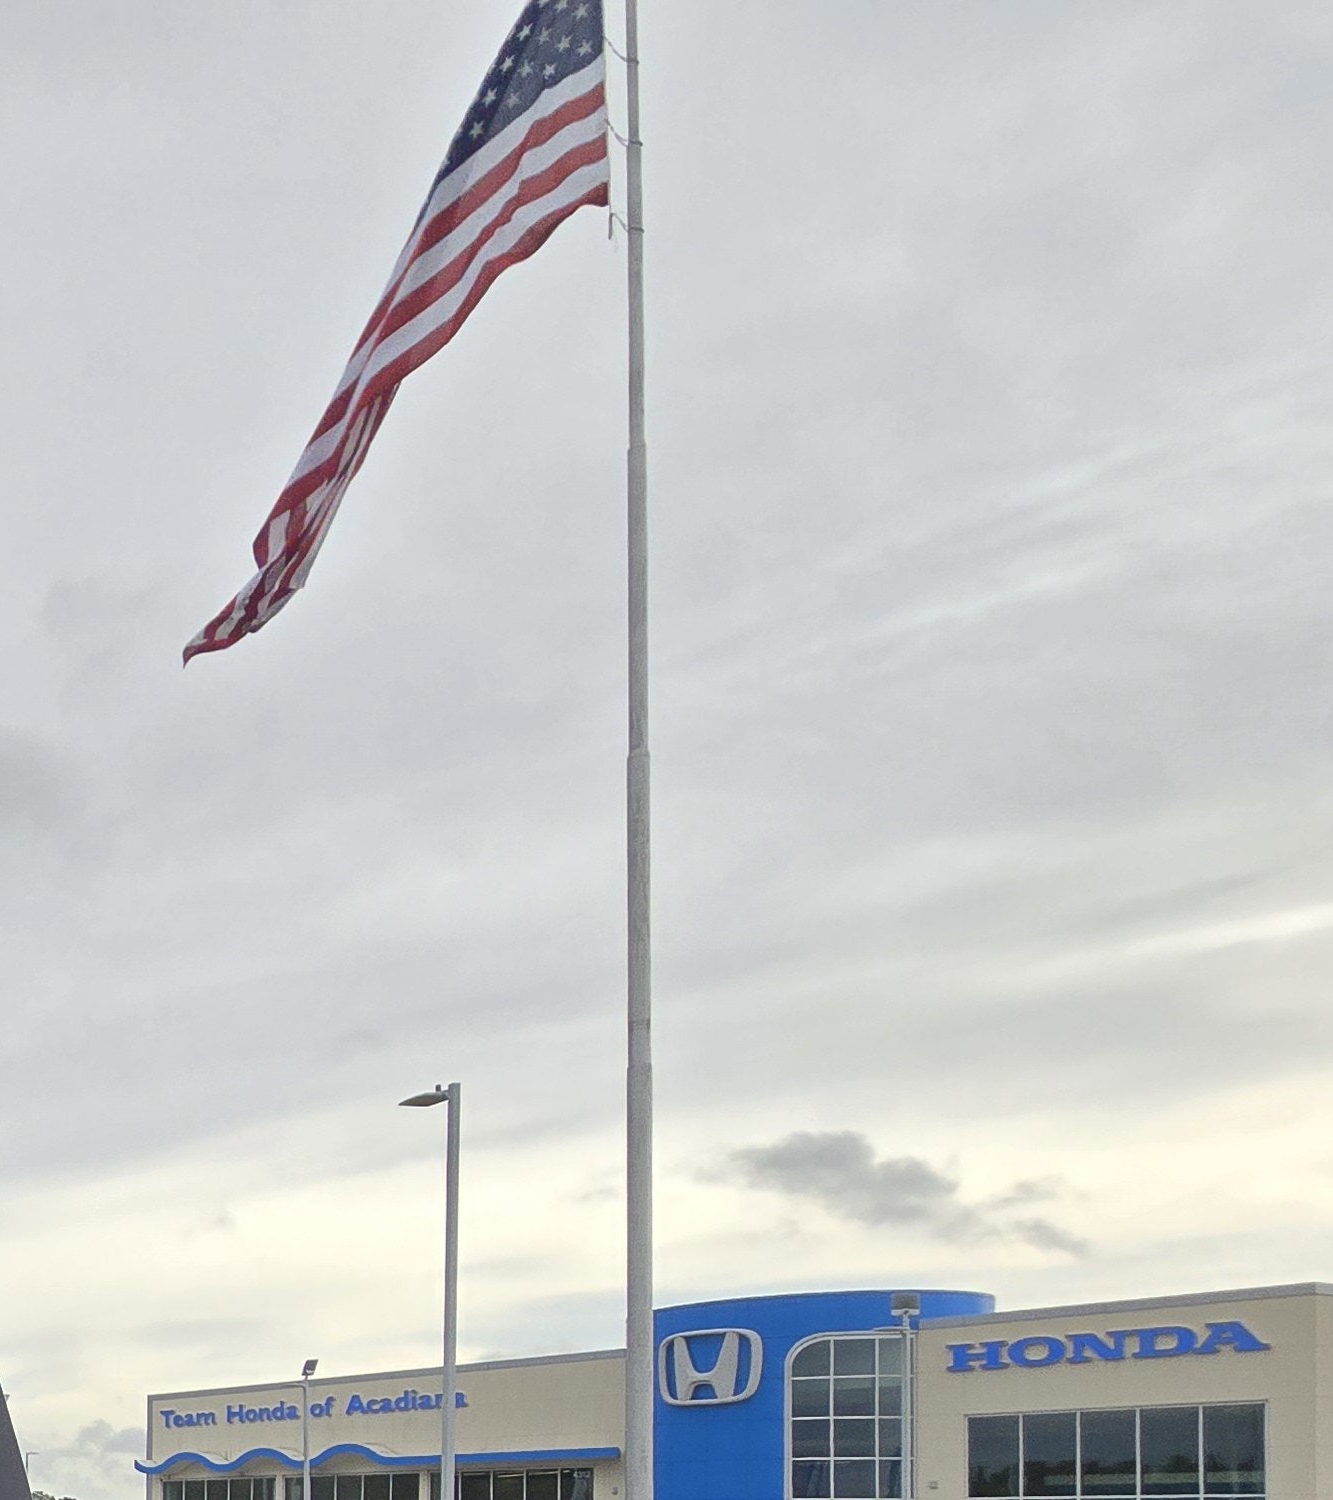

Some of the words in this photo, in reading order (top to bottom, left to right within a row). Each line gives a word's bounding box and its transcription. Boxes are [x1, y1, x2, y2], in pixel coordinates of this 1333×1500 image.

[944, 1320, 1271, 1373] HONDA
[160, 1409, 217, 1429] Team
[227, 1401, 300, 1424] Honda
[309, 1396, 336, 1418] of
